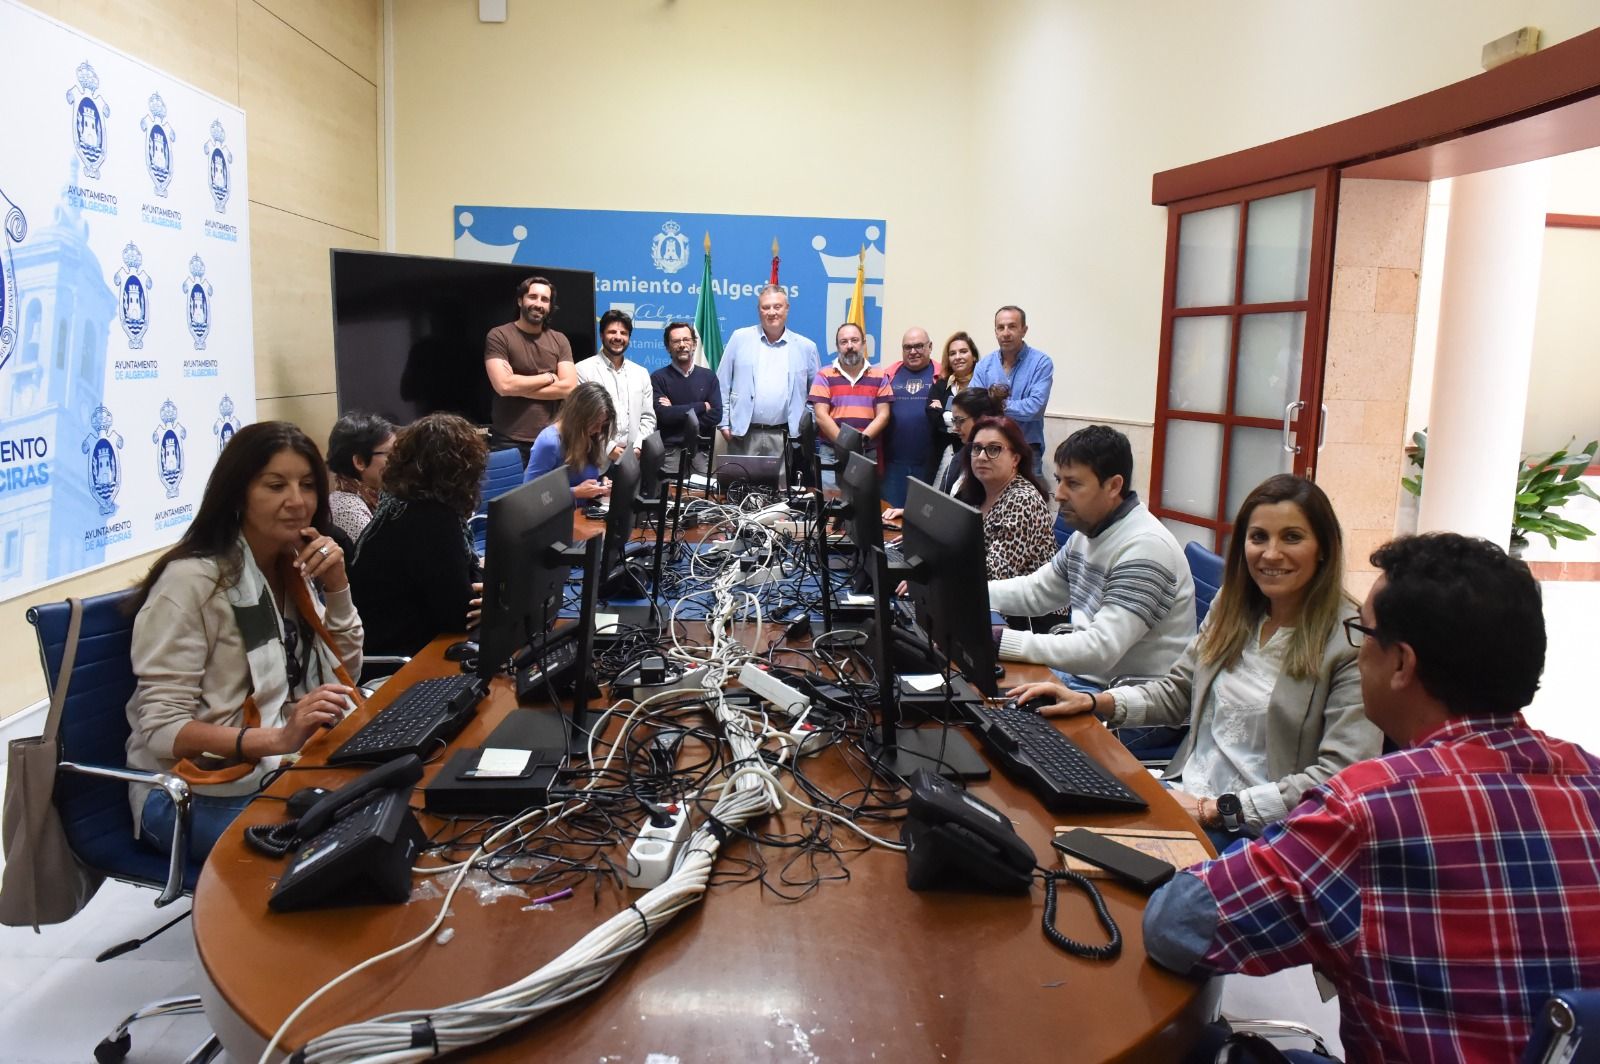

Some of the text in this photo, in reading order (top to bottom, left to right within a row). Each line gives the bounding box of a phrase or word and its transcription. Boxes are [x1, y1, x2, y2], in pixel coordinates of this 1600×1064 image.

[67, 184, 118, 205] AYUNTAMIENTO
[68, 195, 118, 215] DE ALGECIRAS
[141, 203, 182, 221] AYUNTAMIENTO
[151, 215, 182, 230] ALGECIRAS
[204, 218, 238, 234] AYUNTAMIENTO
[212, 229, 238, 242] ALGECIRAS
[114, 360, 158, 369] AYUNTAMIENTO
[183, 359, 218, 368] AYUNTAMIENTO
[114, 370, 159, 380] DE ALGECIRAS
[192, 368, 218, 377] ALGECIRAS
[155, 503, 193, 520] AYUNTAMIENTO
[163, 512, 193, 528] ALGECIRAS
[84, 519, 132, 541] AYUNTAMIENTO
[85, 530, 132, 552] DE ALGECIRAS
